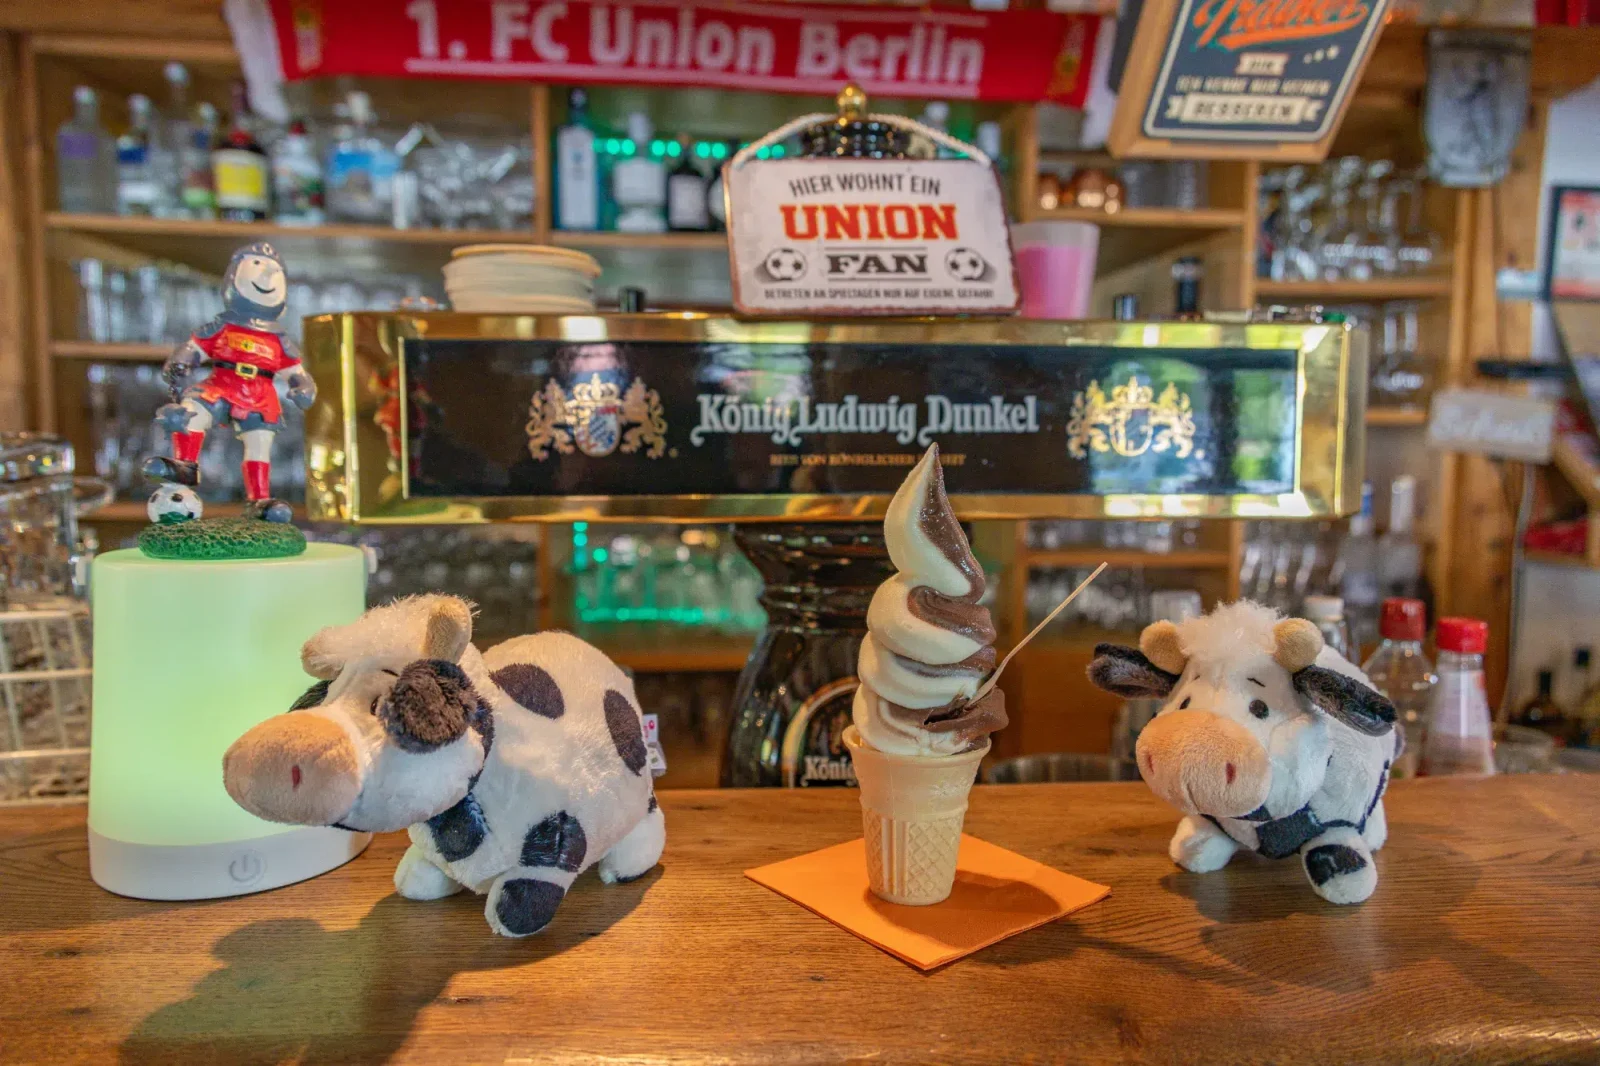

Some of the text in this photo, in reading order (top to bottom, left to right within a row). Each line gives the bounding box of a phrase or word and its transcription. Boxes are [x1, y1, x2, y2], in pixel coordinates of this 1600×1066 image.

[405, 0, 984, 84] 1. FC Union Berlin
[789, 172, 942, 197] HIER WOHNT EIN
[779, 203, 960, 241] UNION
[826, 253, 929, 275] FAN
[764, 287, 811, 299] BETRETEN
[814, 287, 827, 299] AN
[828, 287, 881, 299] SPIELTAGEN
[883, 287, 902, 299] NUR
[904, 287, 921, 299] AUF
[923, 287, 954, 299] EIGENE
[690, 395, 1040, 447] König Ludwig Dunkel
